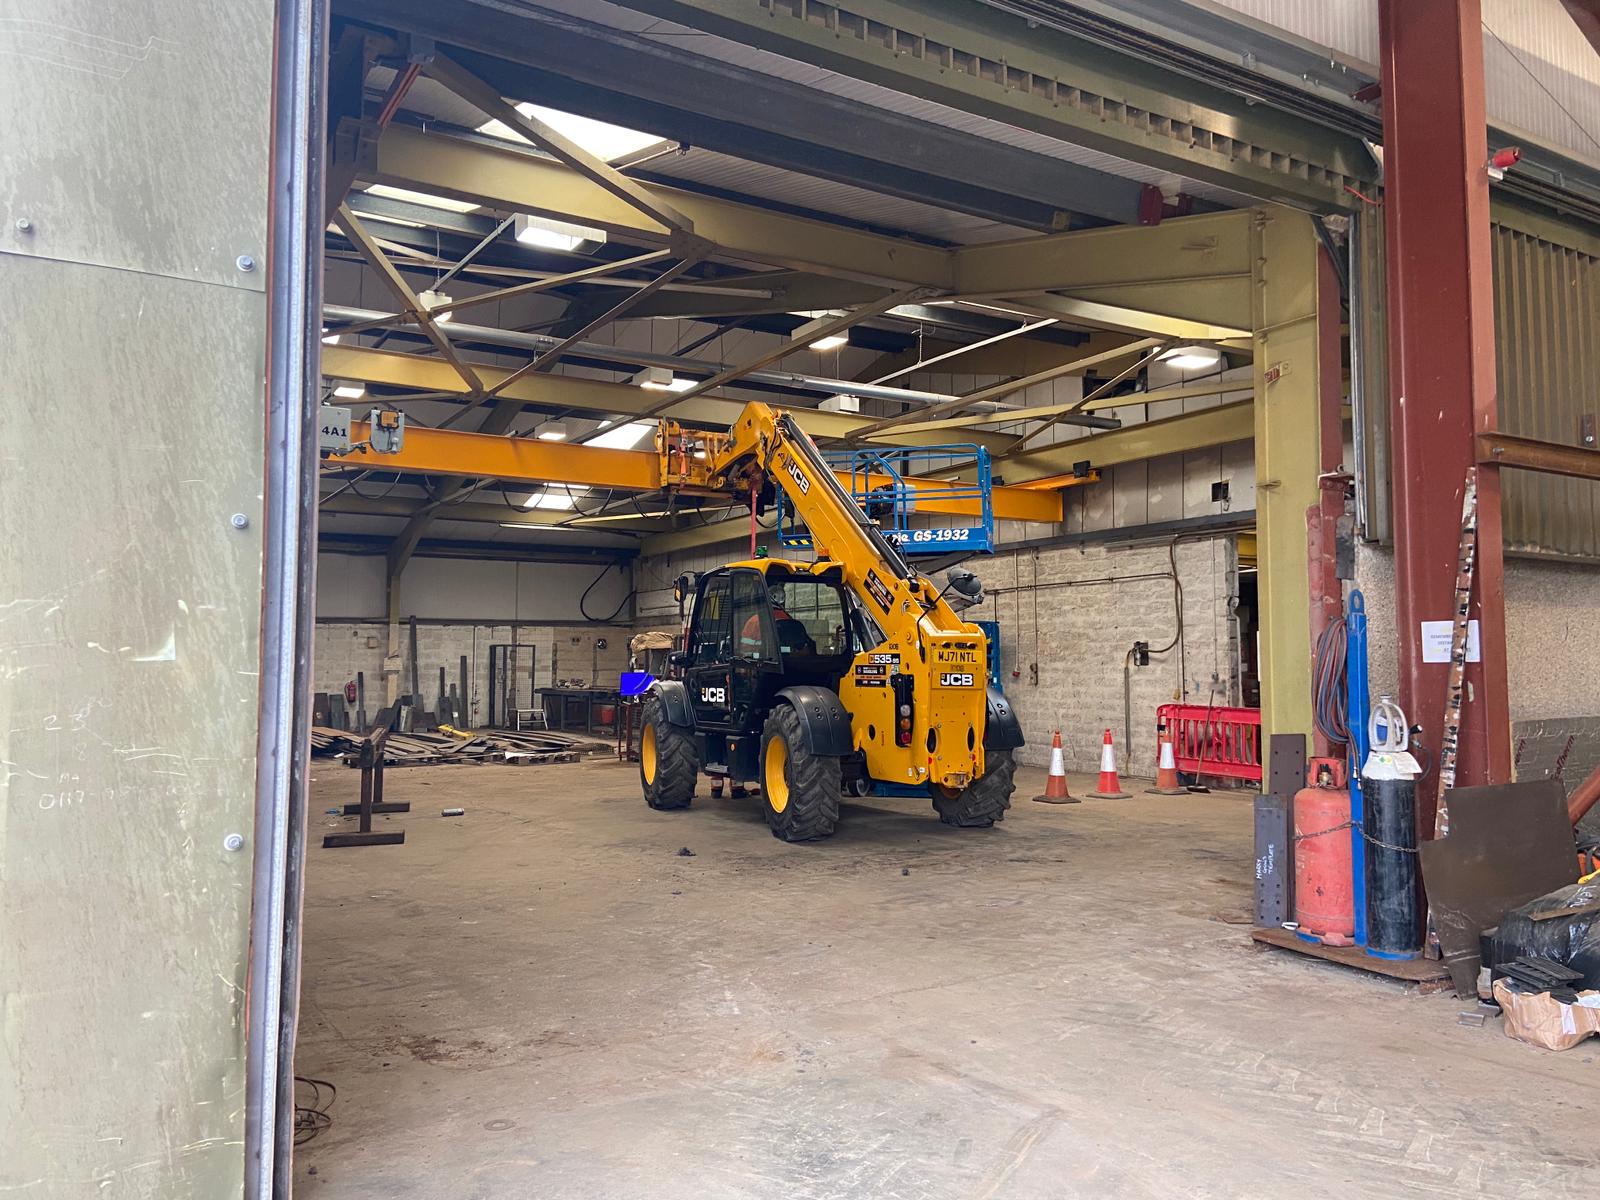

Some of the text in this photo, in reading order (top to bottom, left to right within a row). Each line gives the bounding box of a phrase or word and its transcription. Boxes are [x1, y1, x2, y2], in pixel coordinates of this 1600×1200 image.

[321, 426, 347, 437] 4A1
[788, 460, 810, 494] JCB
[913, 529, 969, 542] GS-1932
[960, 652, 977, 663] NTL
[941, 674, 974, 686] JCB
[701, 688, 725, 702] JCB
